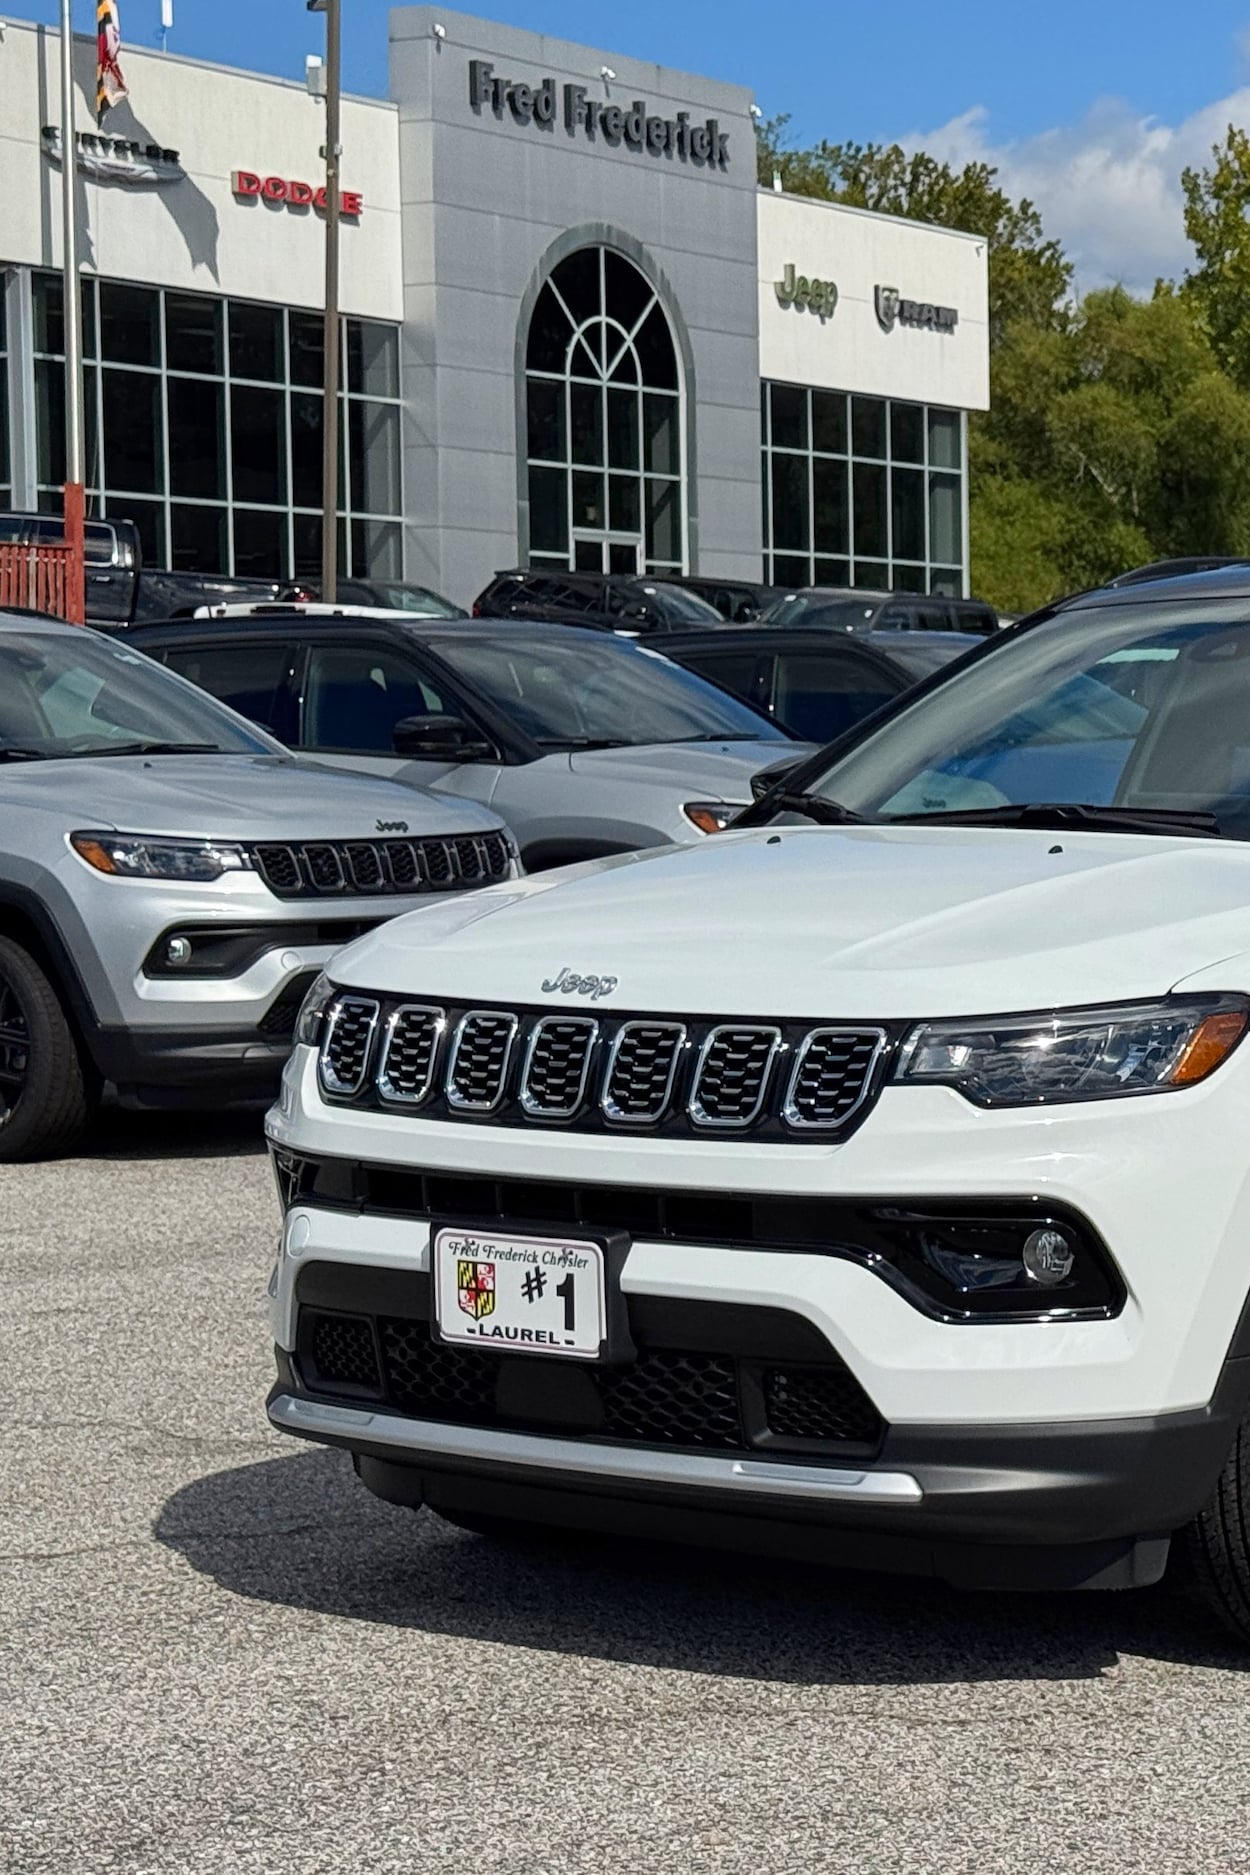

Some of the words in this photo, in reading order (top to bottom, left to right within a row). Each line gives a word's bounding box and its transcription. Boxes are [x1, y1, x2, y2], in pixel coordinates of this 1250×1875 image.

[468, 60, 556, 122] Fred
[564, 83, 730, 164] Frederick
[774, 264, 838, 321] Jeep
[375, 818, 409, 833] Jeep
[541, 967, 618, 1001] Jeep
[448, 1241, 480, 1257] Fred
[483, 1244, 539, 1264] Frederick
[542, 1251, 589, 1269] Chrysler
